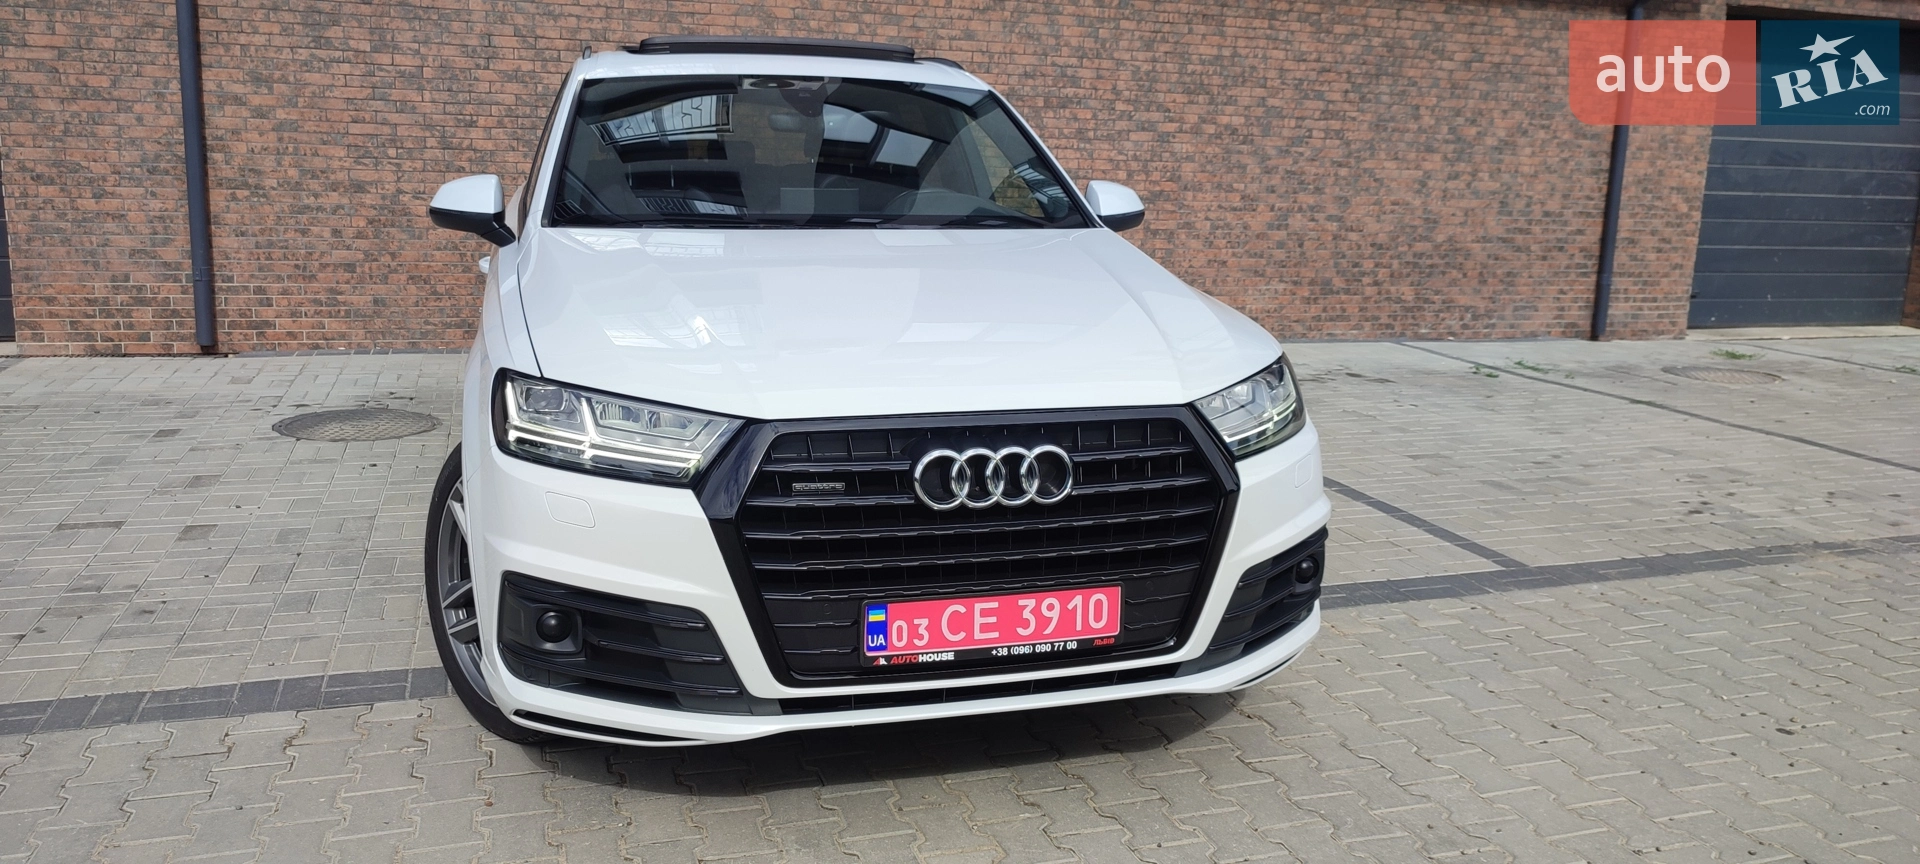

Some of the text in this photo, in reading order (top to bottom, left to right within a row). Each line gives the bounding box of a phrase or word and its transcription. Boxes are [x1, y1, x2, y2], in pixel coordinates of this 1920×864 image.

[892, 592, 1109, 648] 03 CE 3910
[868, 634, 887, 647] UA
[991, 640, 1078, 657] +38 (096) 090 77 00
[890, 651, 955, 664] AUTOHOUSE
